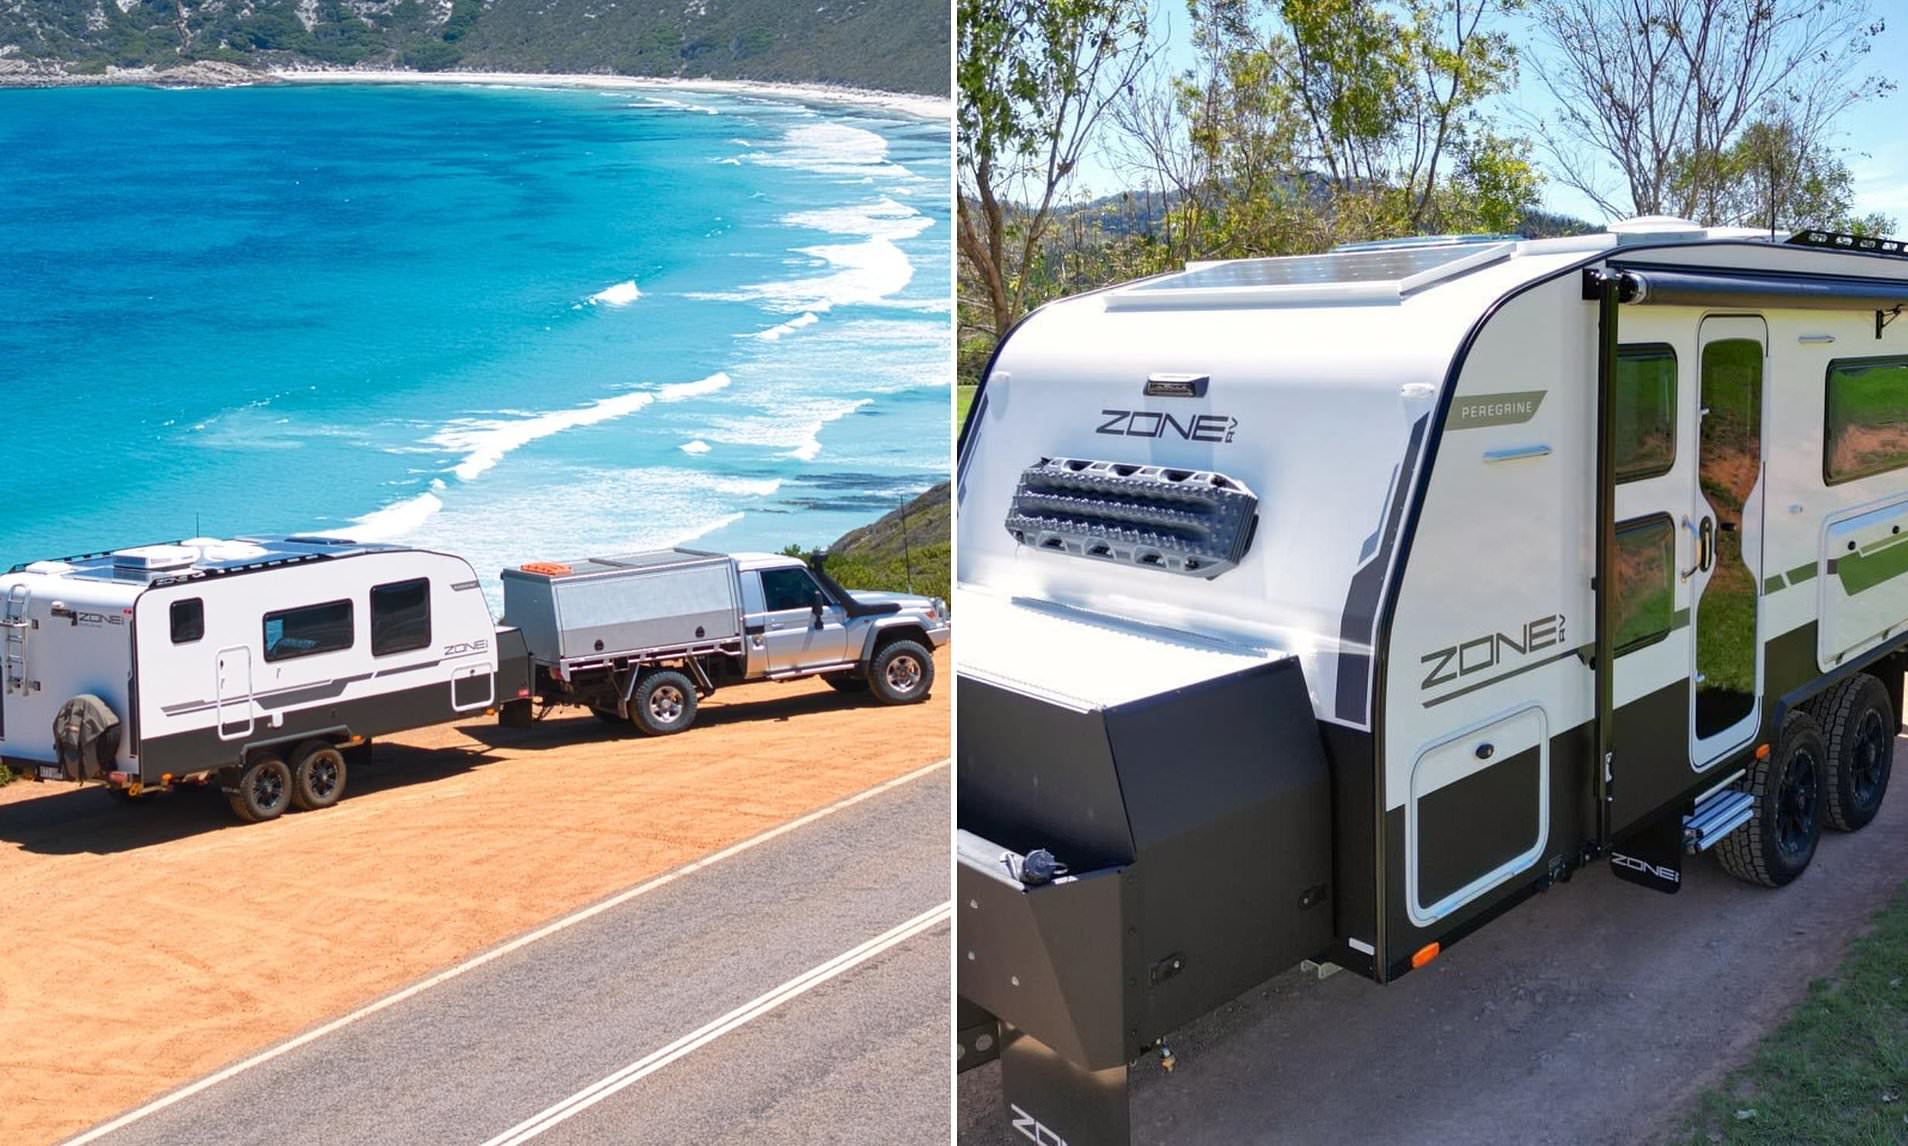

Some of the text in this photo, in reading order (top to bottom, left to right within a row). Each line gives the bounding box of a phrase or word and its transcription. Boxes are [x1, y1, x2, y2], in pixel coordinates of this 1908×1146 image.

[1462, 401, 1532, 419] PEREGRINE
[1096, 409, 1239, 444] ZONE RV
[79, 612, 121, 625] ZONE
[444, 640, 485, 656] ZONE
[1420, 613, 1566, 691] ZONE RV
[1611, 852, 1675, 882] ZONE
[1011, 1103, 1068, 1146] ZO
